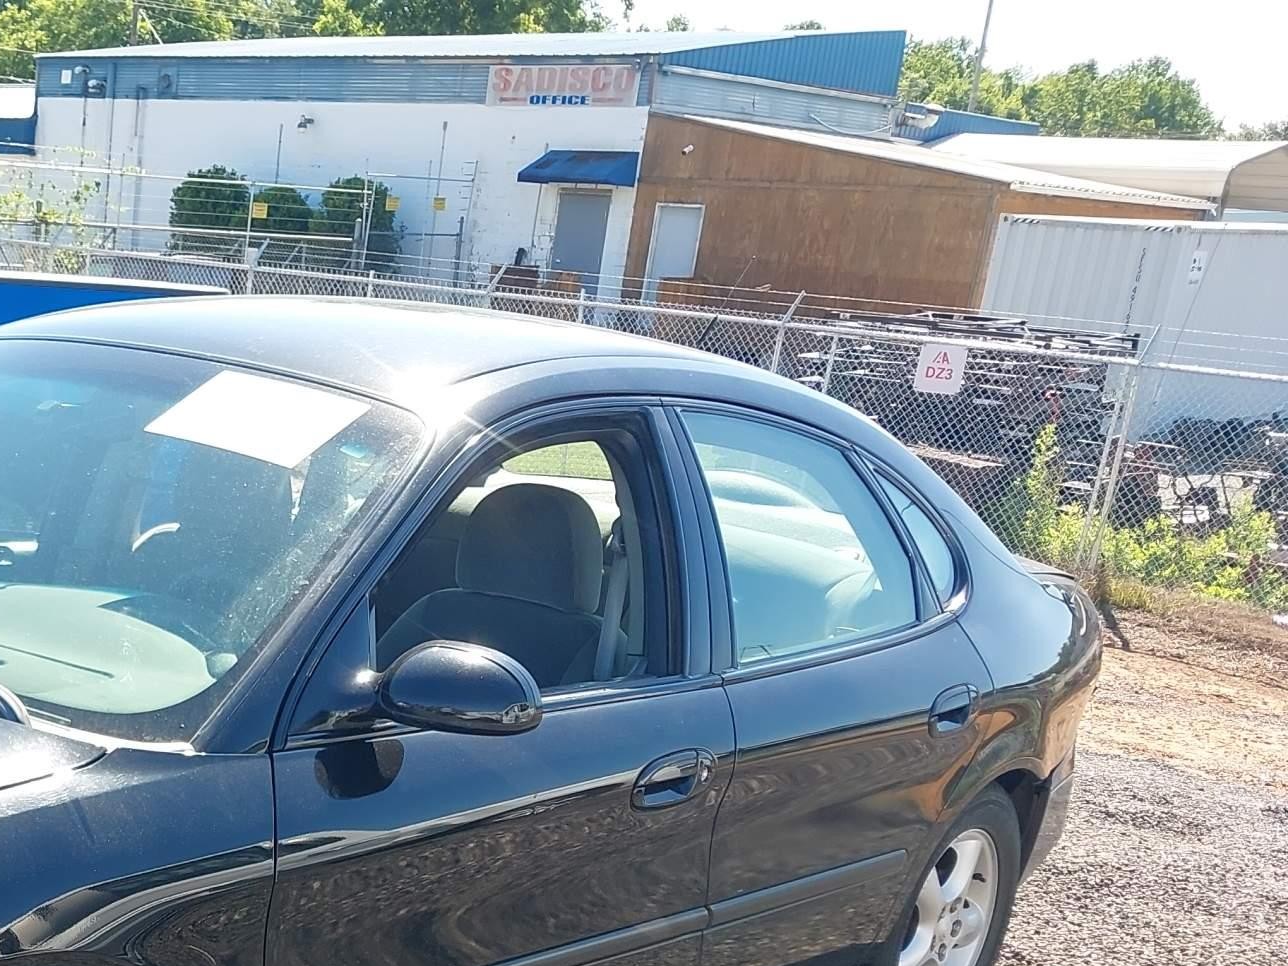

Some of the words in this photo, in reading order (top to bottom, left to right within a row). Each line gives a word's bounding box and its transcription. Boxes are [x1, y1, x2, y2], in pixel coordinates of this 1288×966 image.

[492, 66, 636, 92] SADISCO
[529, 95, 591, 105] OFFICE
[925, 366, 953, 380] DZ3
